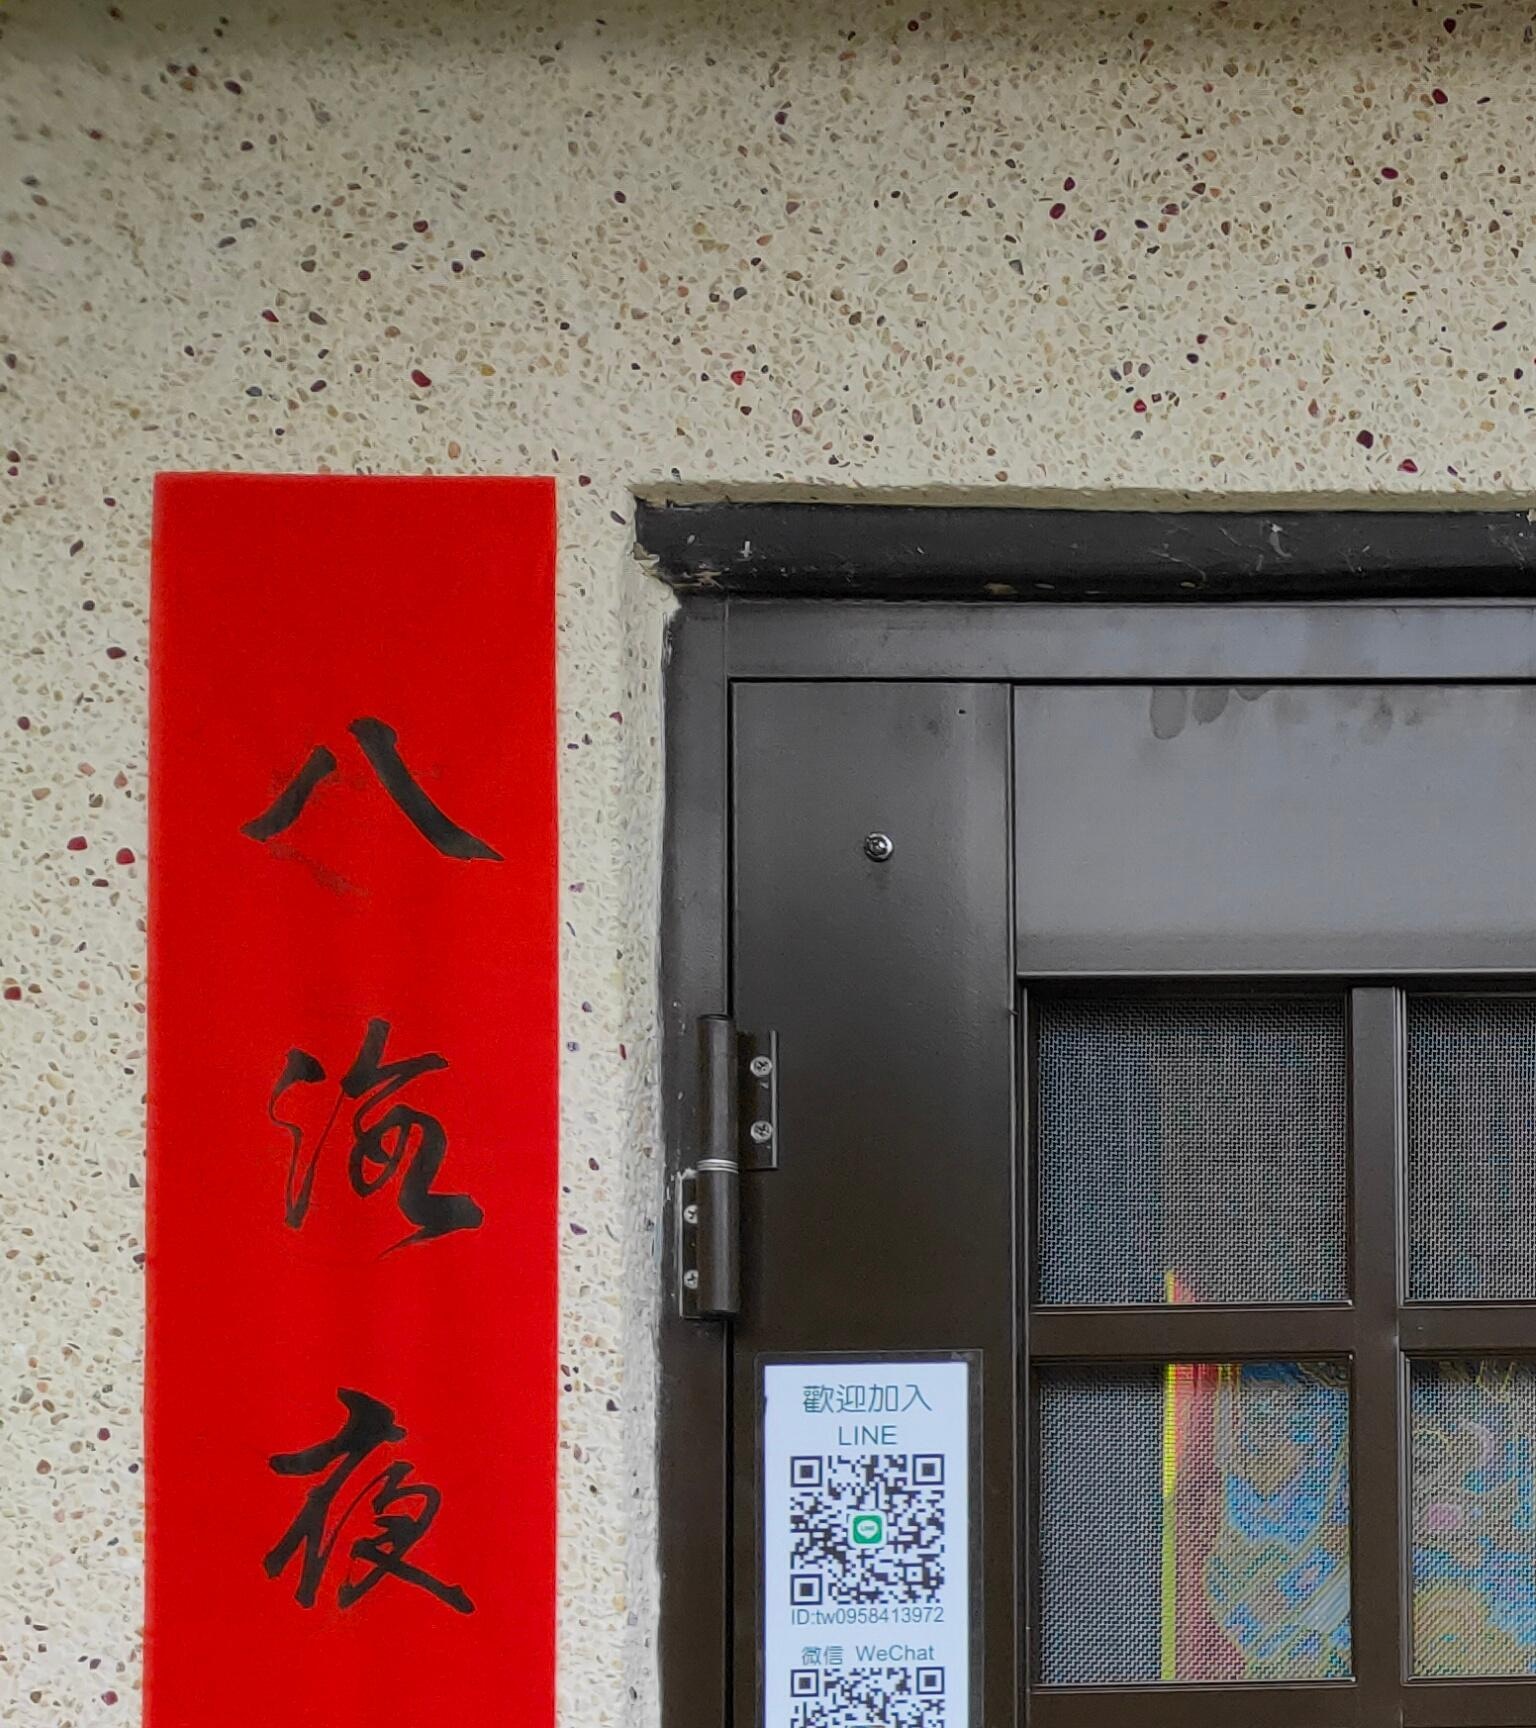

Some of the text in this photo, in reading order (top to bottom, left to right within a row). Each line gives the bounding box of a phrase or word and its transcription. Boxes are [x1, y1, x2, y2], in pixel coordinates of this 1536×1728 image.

[802, 1384, 933, 1413] 歡迎加入
[838, 1425, 898, 1445] LINE
[791, 1607, 945, 1625] ID:tw0958413972
[801, 1645, 935, 1666] 微信 WeChat
